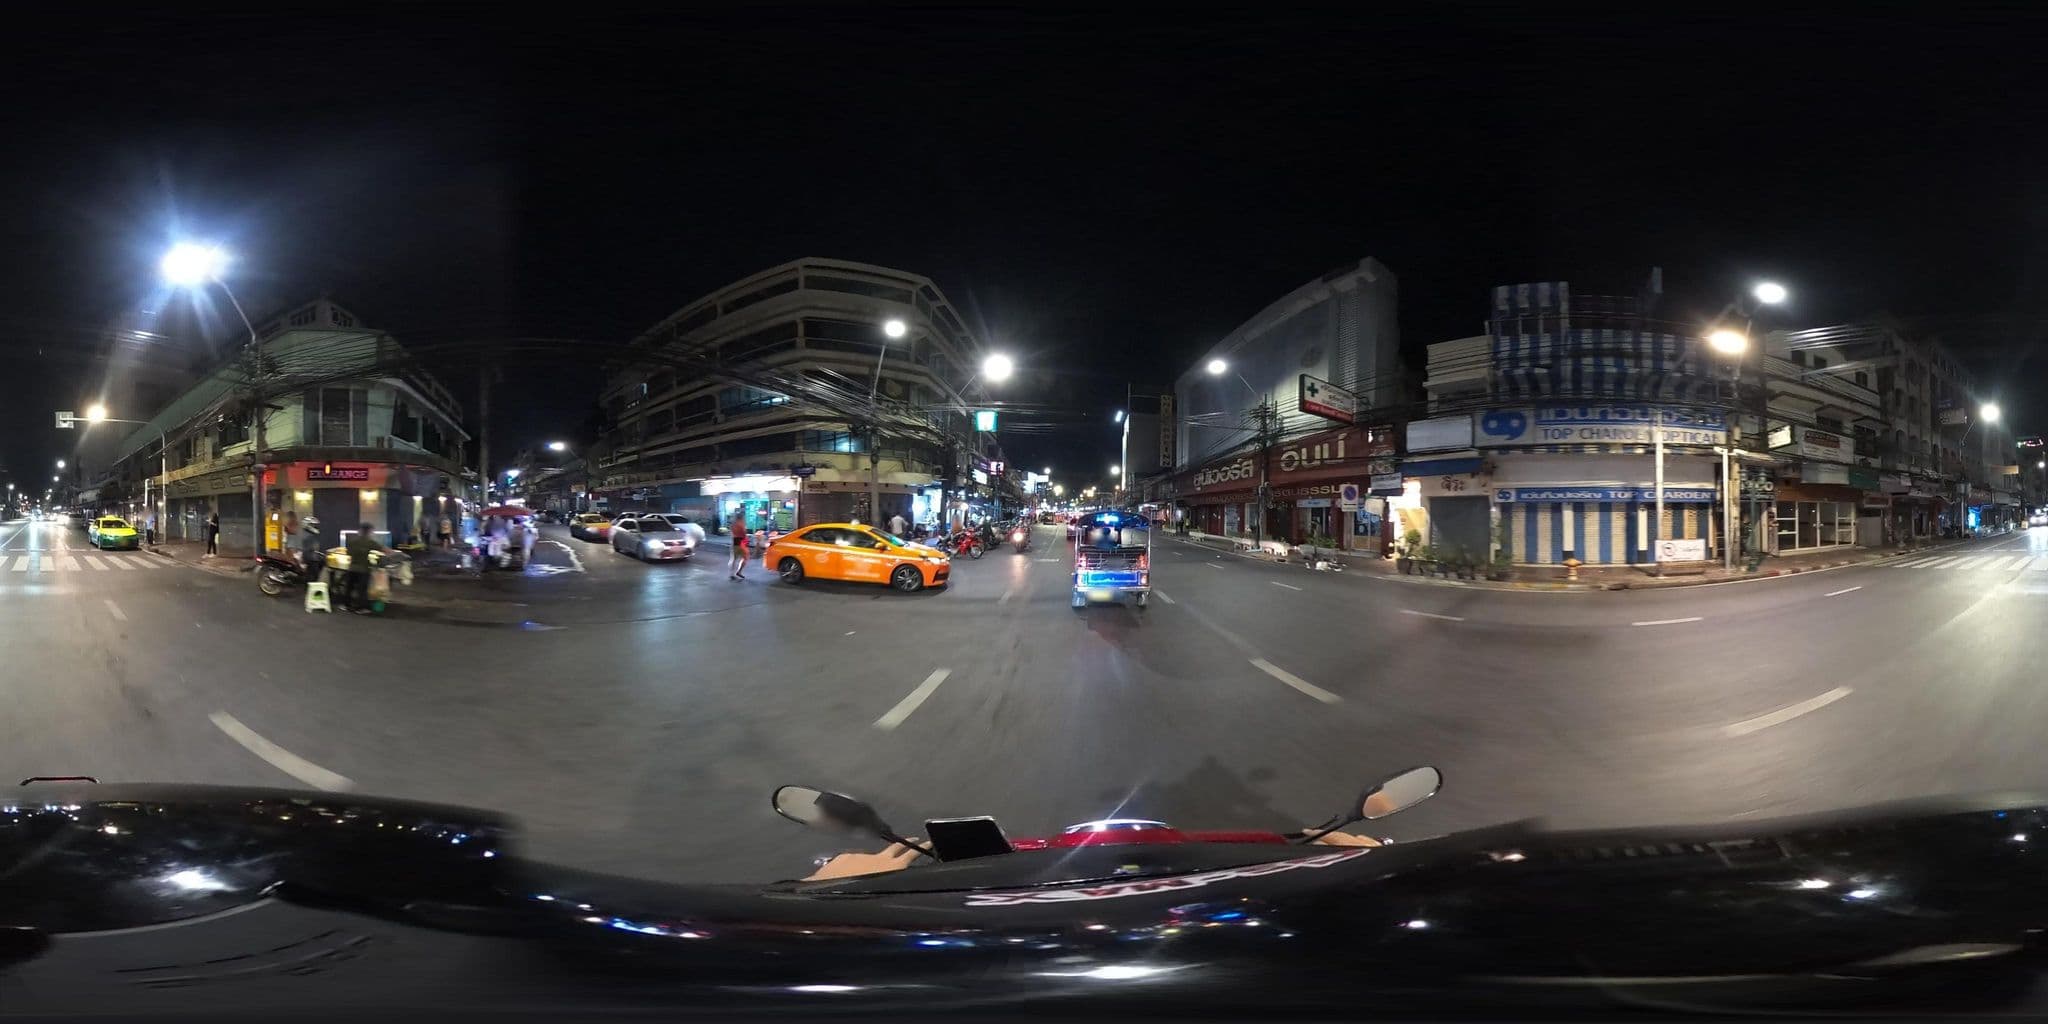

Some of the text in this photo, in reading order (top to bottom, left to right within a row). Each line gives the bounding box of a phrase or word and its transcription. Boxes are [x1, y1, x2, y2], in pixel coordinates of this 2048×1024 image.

[1542, 427, 1573, 440] TOP
[310, 470, 368, 479] EXHANGE
[1644, 491, 1711, 499] CAROEN
